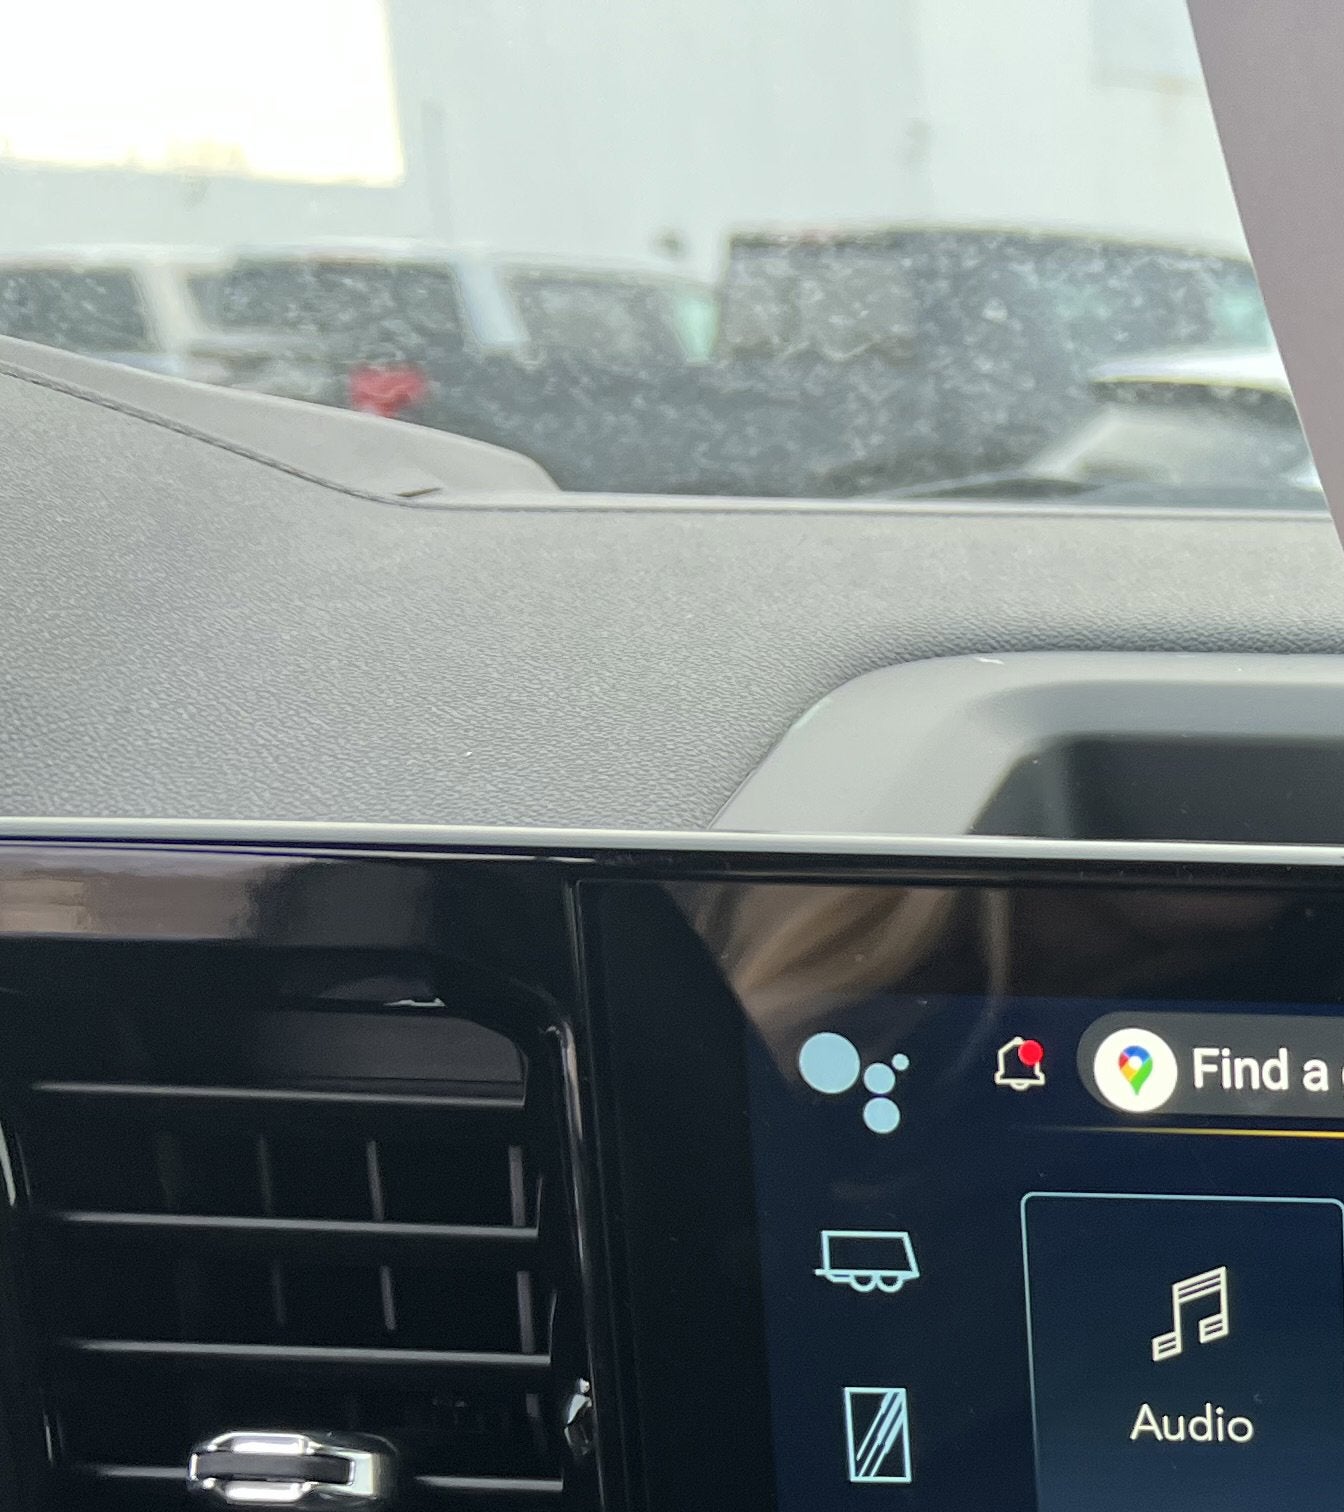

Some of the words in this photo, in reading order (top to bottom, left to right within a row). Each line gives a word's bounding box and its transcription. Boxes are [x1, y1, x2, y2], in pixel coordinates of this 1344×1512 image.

[1192, 1048, 1288, 1091] Find
[1303, 1061, 1329, 1092] a
[1130, 1404, 1254, 1443] Audio
